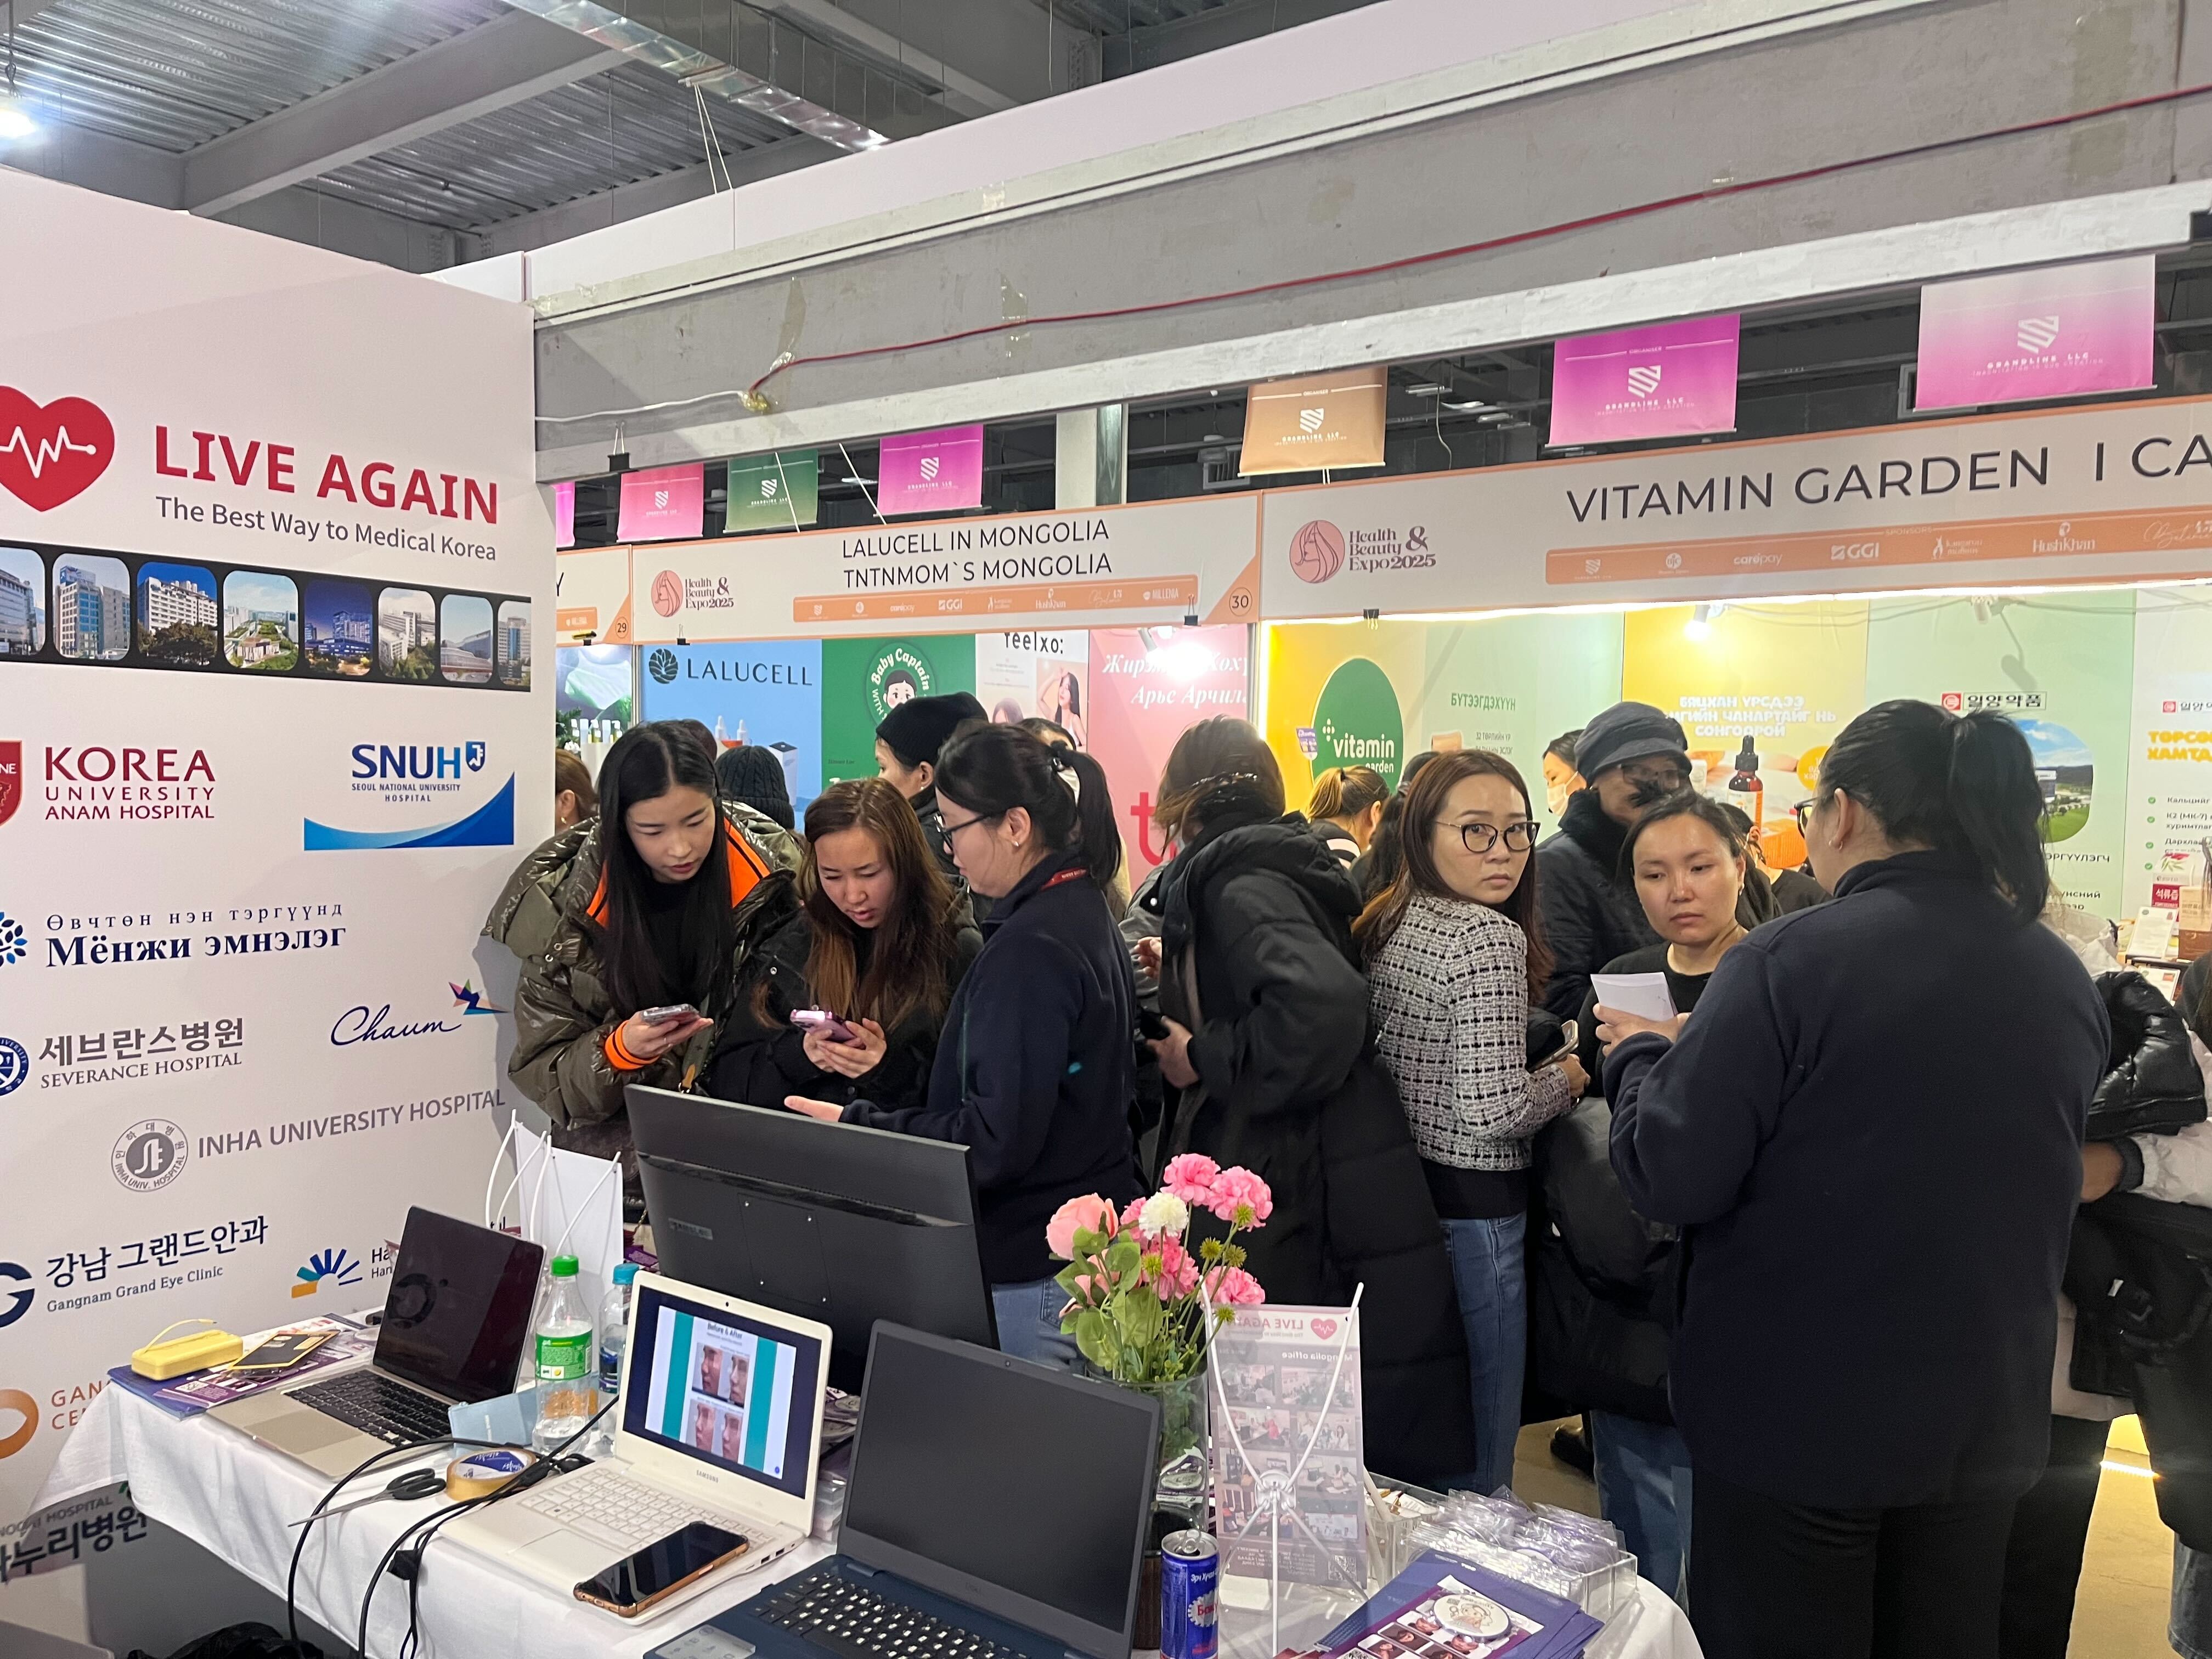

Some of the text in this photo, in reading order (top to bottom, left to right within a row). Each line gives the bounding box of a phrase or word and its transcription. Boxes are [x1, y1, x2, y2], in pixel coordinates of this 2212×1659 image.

[155, 425, 499, 524] LIVE AGAIN
[1566, 472, 1773, 522] VITAMIN
[1795, 447, 2048, 504] GARDEN
[156, 496, 496, 561] The Best Way to Medical Korea
[843, 519, 1109, 558] LALUCELL IN MONGOLIA
[1349, 525, 1429, 551] Health &
[1350, 542, 1402, 556] Beauty
[1847, 543, 1880, 558] GGI
[983, 552, 1113, 580] MONGOLIA
[685, 577, 730, 595] Health &
[686, 589, 714, 599] Beauty
[946, 599, 963, 611] GGI
[1232, 595, 1250, 608] 30
[617, 623, 627, 633] 29
[687, 658, 812, 686] LALUCELL
[871, 648, 930, 691] Baby Captain
[872, 689, 884, 715] WITH
[1130, 685, 1177, 710] Арьс
[1451, 692, 1516, 712] БҮТЭЭГДЭХҮҮН
[1679, 696, 1737, 712] БЯЦХАН
[1967, 693, 2042, 708] 일양약품
[1723, 709, 1810, 725] ЧАНАРТАЙГ
[1815, 710, 1836, 723] НЬ
[1694, 724, 1786, 738] СОНГООРОЙ
[2147, 730, 2212, 744] ТӨРСӨ
[1333, 733, 1395, 759] vitamin
[45, 747, 216, 782] KOREA
[351, 743, 461, 779] SNUH
[46, 786, 215, 801] UNIVERSITY
[385, 794, 431, 802] HOSPITAL
[45, 805, 215, 820] ANAM HOSPITAL
[47, 904, 343, 930] Өвчтөн нэн тэргүүнд
[46, 927, 347, 968] Мёнжи эмнэлэг
[330, 1003, 462, 1046] Chaum
[38, 1017, 244, 1067] 세브란스병원
[41, 1063, 149, 1090] SEVERANCE
[155, 1051, 242, 1075] HOSPITAL
[198, 1088, 506, 1159] INHA UNIVERSITY HOSPITAL
[115, 1163, 129, 1183] INHA
[153, 1155, 185, 1188] HOSPITAL
[46, 1215, 269, 1288] 강남 그랜드안과
[371, 1247, 389, 1264] Ha
[47, 1265, 224, 1313] Gangnam Grand Eye Clinic
[51, 1380, 111, 1408] GAN
[52, 1408, 87, 1431] CE
[696, 1470, 719, 1483] SAMSUNG
[46, 1496, 113, 1523] HOSPITAL
